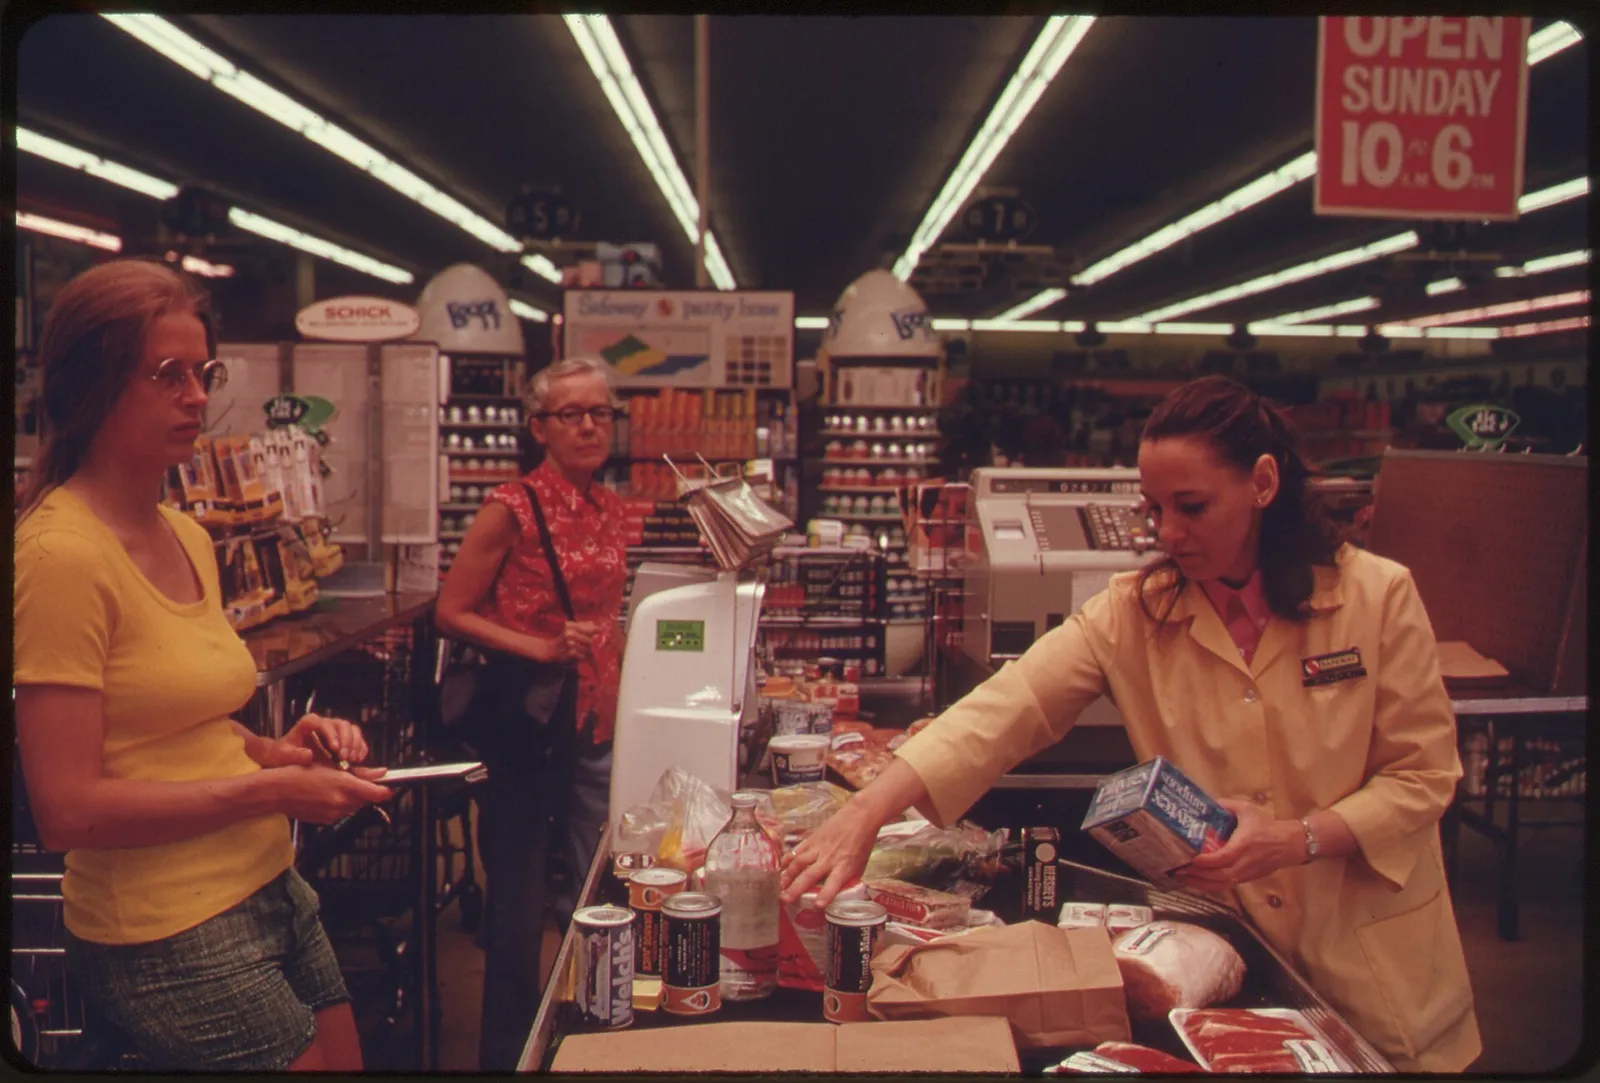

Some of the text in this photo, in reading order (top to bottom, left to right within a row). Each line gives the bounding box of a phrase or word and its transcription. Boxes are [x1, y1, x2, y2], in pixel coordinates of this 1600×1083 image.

[1343, 16, 1503, 60] OPEN
[1341, 64, 1502, 118] SUNDAY
[1341, 121, 1403, 188] 10
[1431, 124, 1474, 191] 6
[323, 305, 392, 321] SCHICK
[682, 300, 735, 321] panty
[738, 297, 781, 316] hose
[1150, 787, 1209, 842] playtex
[1043, 864, 1057, 908] HERSHEY'S
[859, 926, 870, 953] Maid
[611, 923, 632, 1026] Welch's
